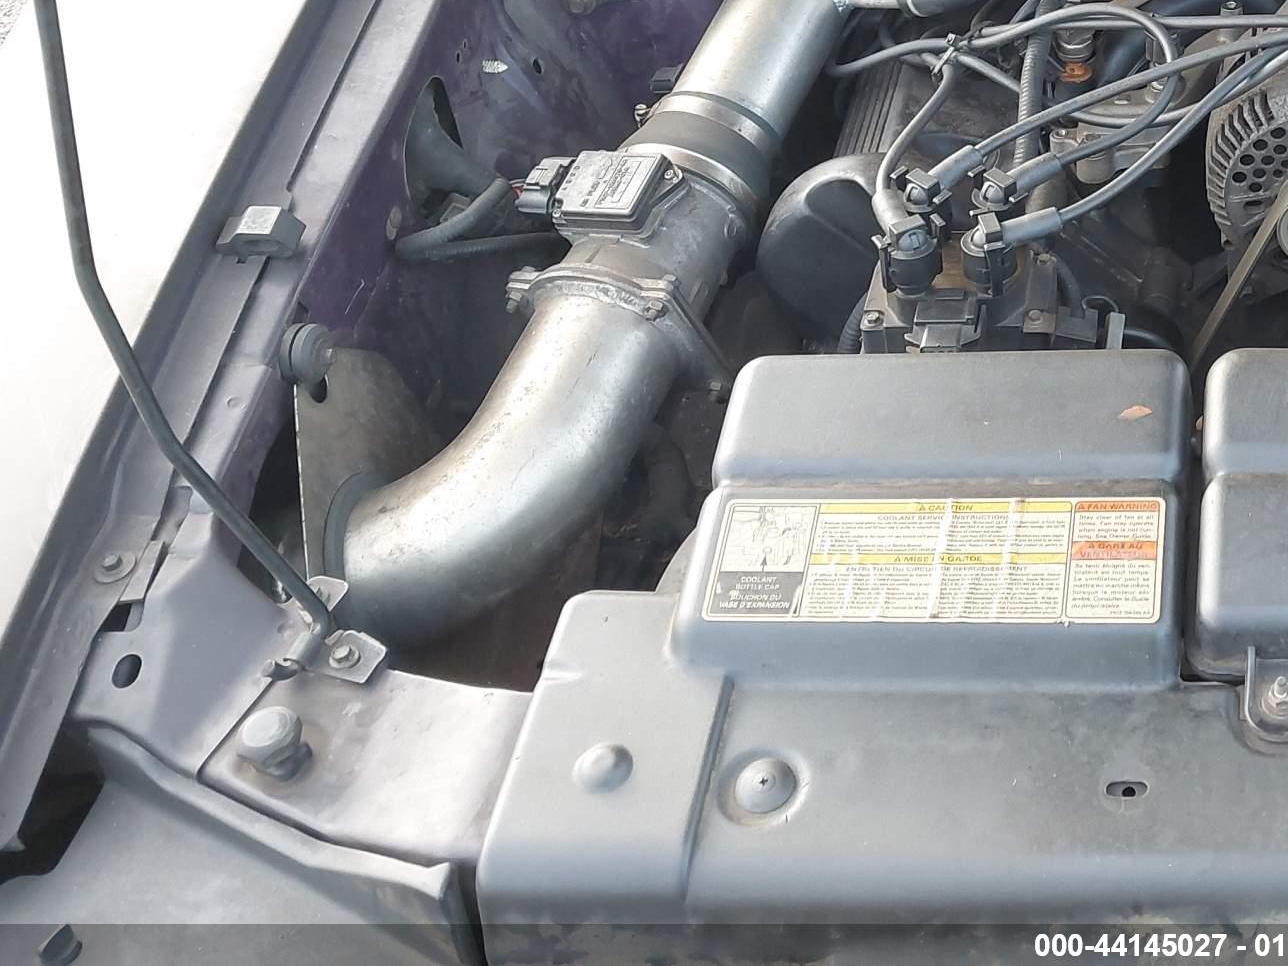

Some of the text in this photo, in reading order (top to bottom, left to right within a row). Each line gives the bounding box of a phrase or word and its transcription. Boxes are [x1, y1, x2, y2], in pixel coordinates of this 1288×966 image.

[730, 593, 782, 601] BOUCHON DU
[719, 601, 738, 609] VASE
